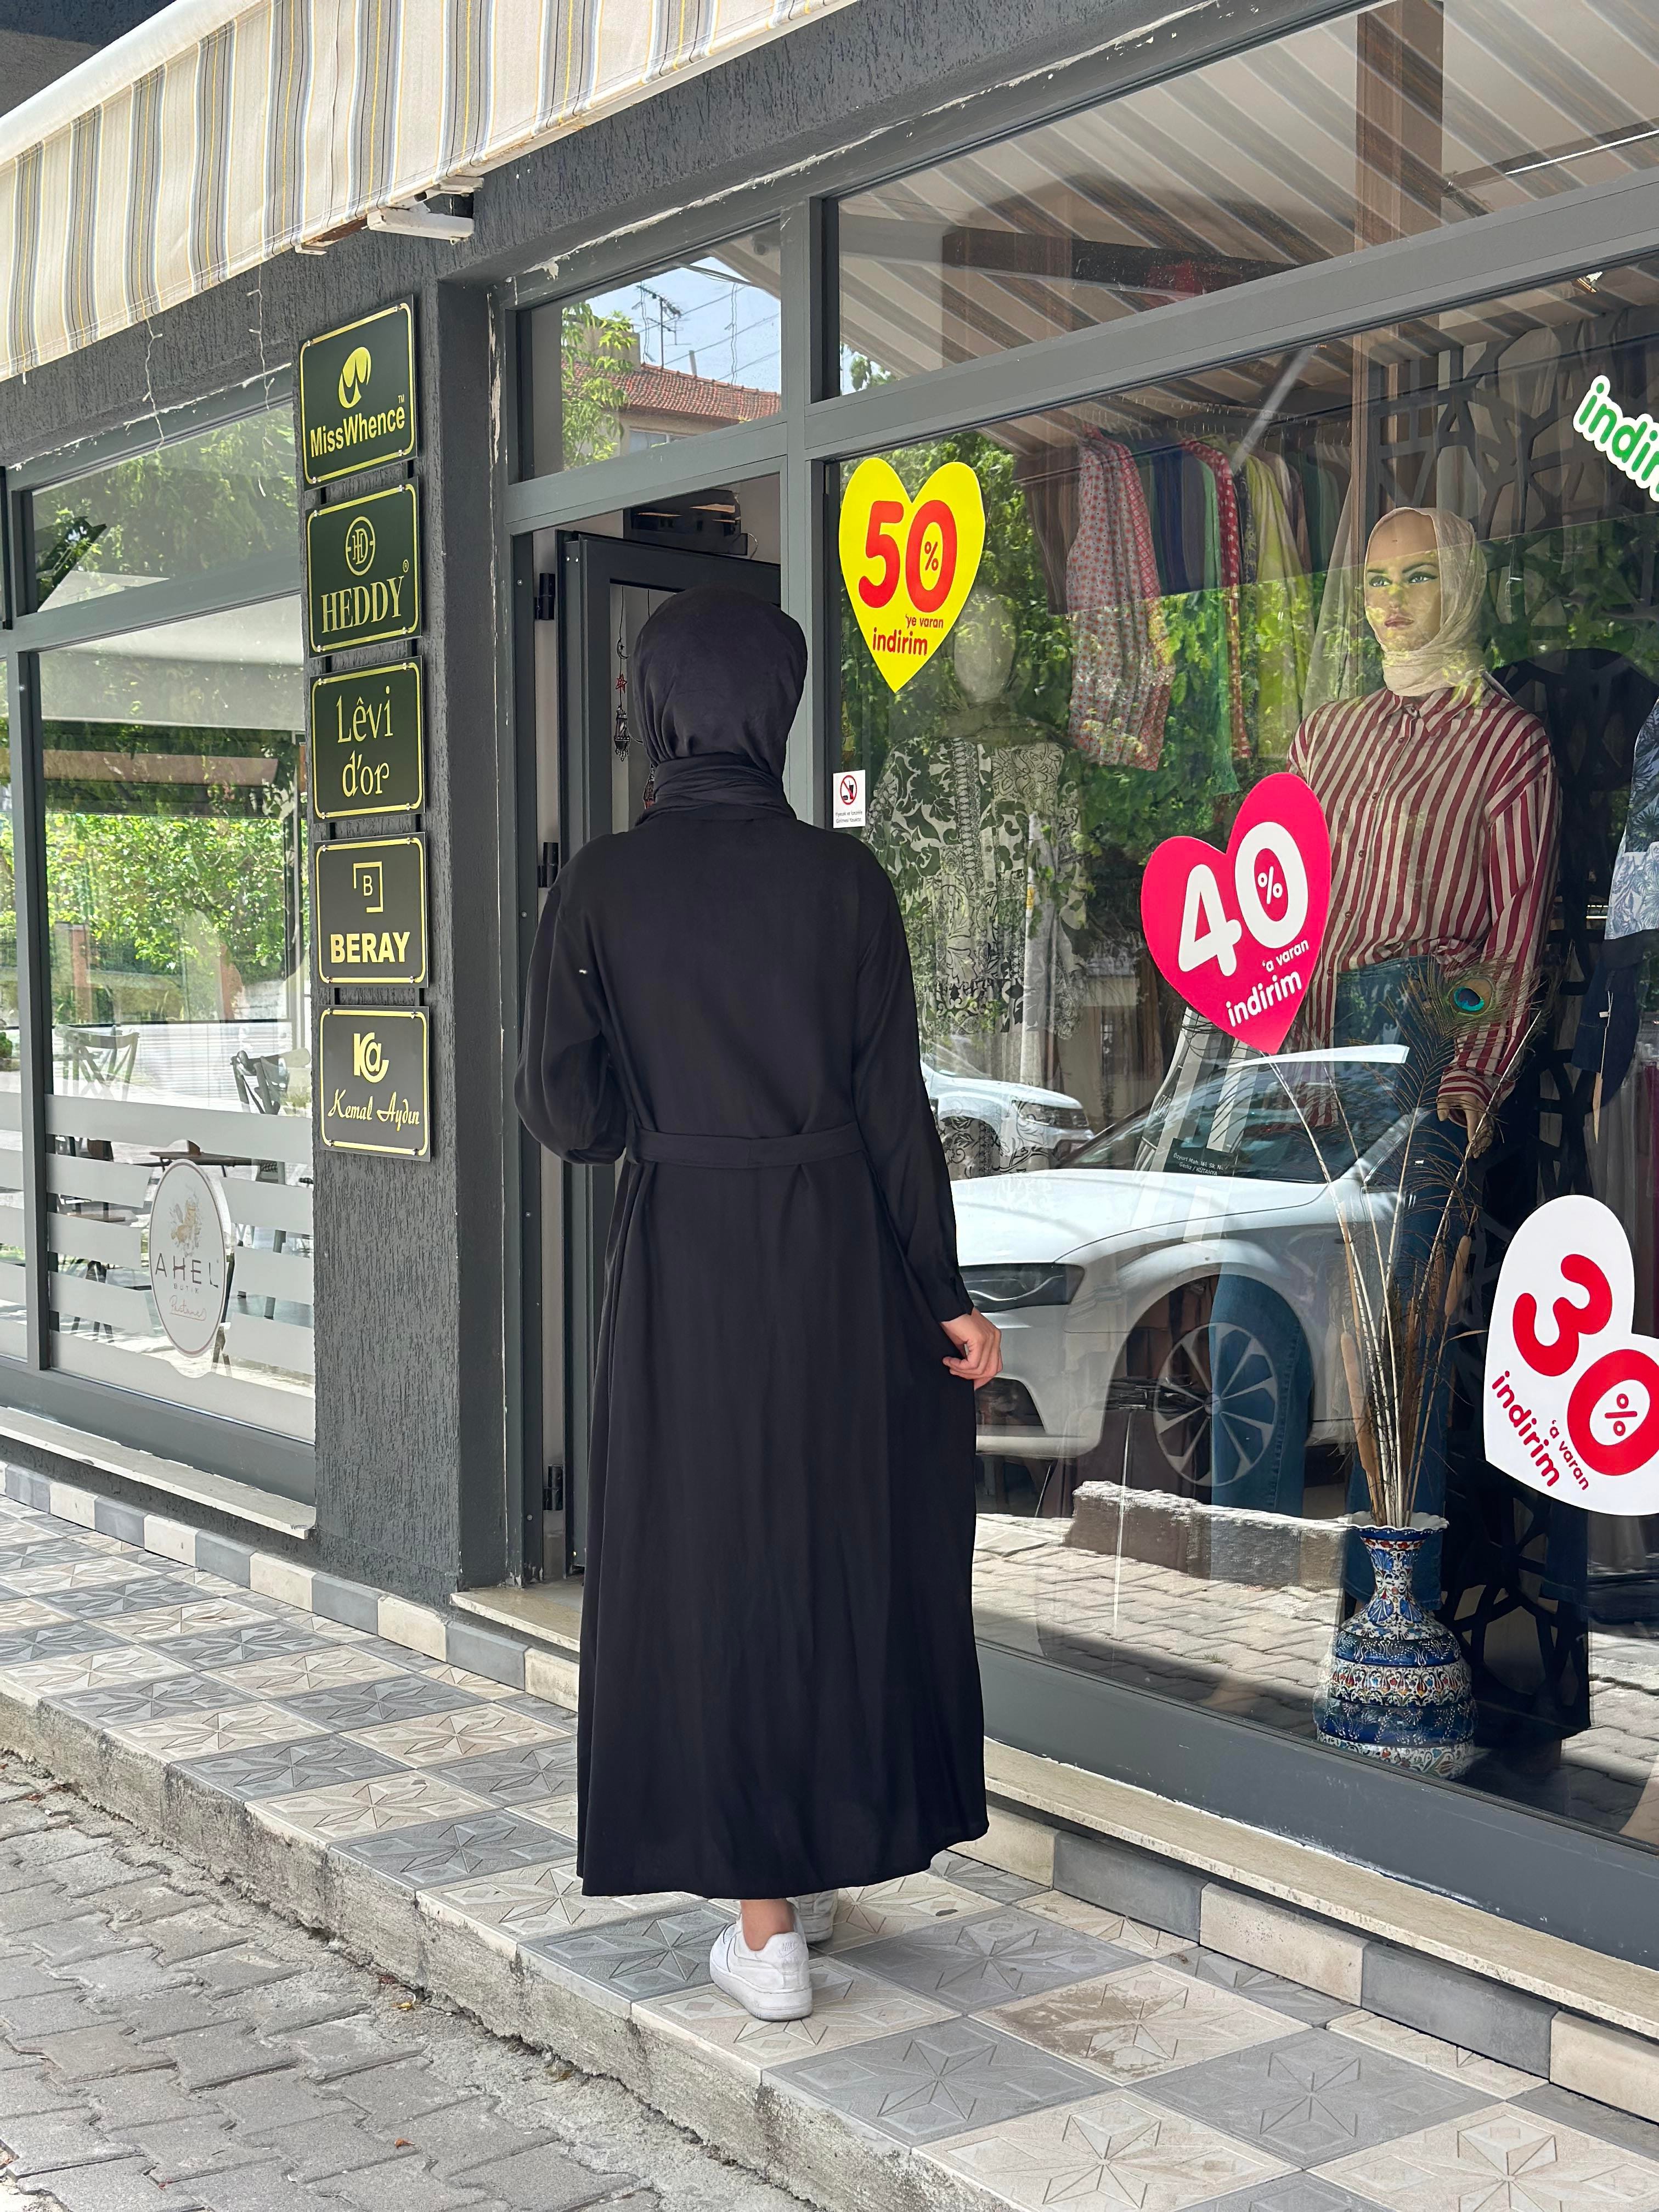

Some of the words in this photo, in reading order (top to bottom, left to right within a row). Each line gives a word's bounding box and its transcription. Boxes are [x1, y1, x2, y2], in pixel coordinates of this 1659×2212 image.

[398, 394, 405, 404] TM
[310, 406, 405, 458] MissWhence
[1578, 382, 1659, 494] indir
[859, 500, 957, 613] 50
[321, 575, 404, 633] HEDDY
[919, 616, 944, 629] varan
[872, 627, 928, 656] indirim
[336, 686, 393, 743] Lêvi
[1178, 821, 1308, 977] 40
[330, 932, 410, 963] BERAY
[1276, 939, 1309, 966] varan
[1226, 970, 1302, 1028] indirim
[328, 1088, 373, 1120] Kemal
[376, 1091, 420, 1132] Aydın
[155, 1253, 218, 1288] AHEL
[1492, 1370, 1560, 1487] indirim
[1559, 1440, 1589, 1490] varan
